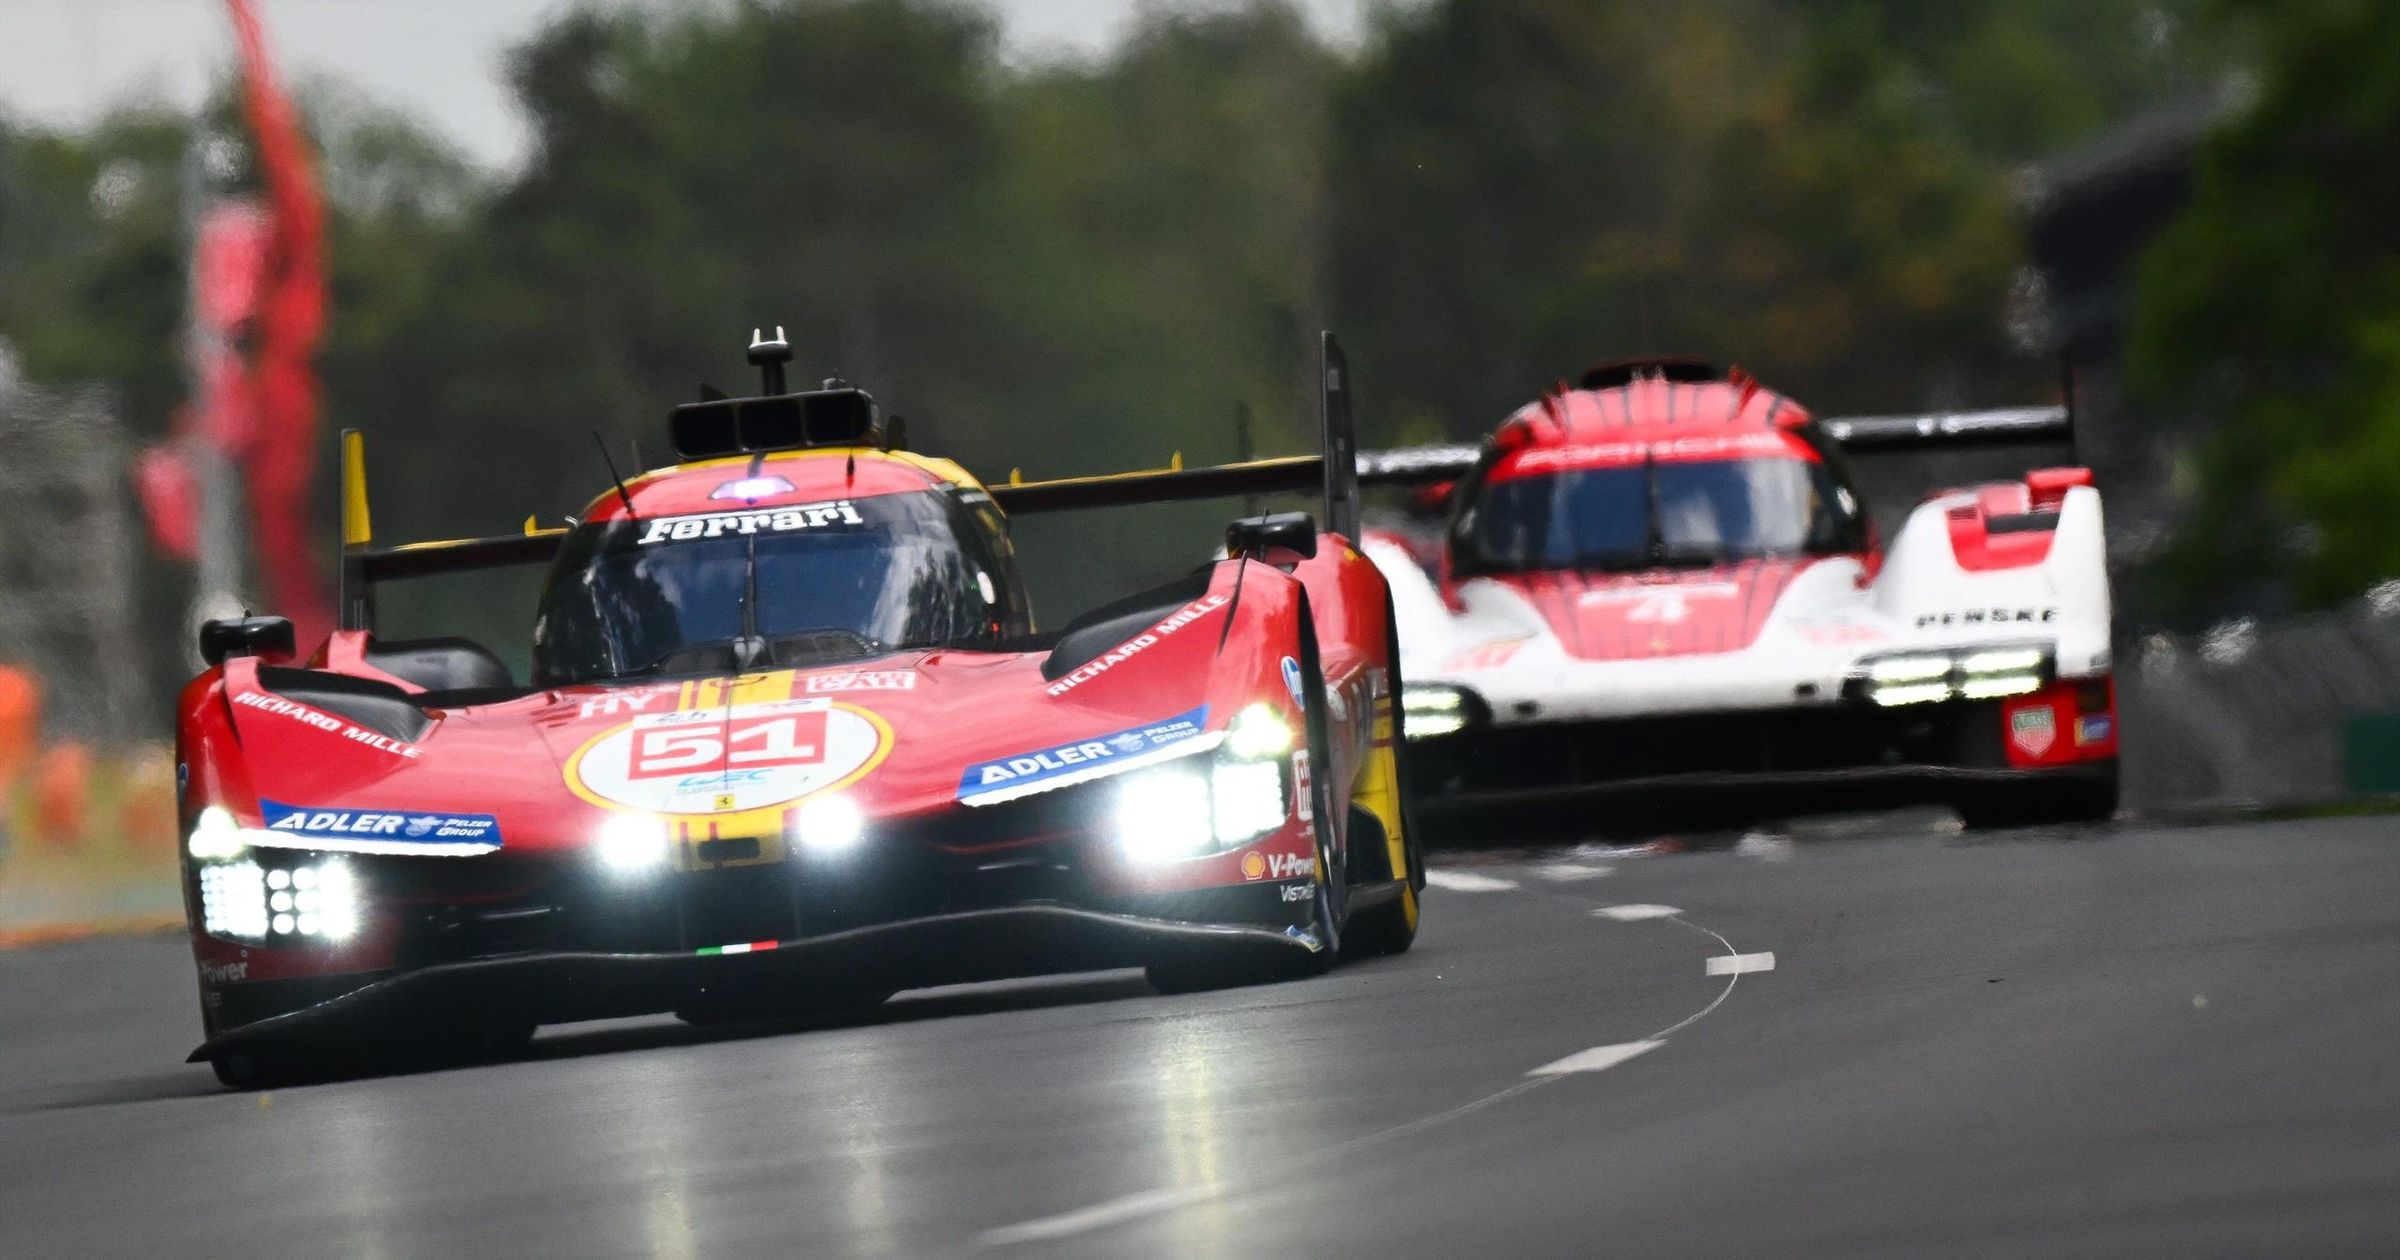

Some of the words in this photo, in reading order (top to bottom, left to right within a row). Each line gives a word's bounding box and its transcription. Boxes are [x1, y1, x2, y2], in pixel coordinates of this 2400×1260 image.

[637, 500, 863, 545] Ferrari
[1916, 607, 2057, 627] PENSKE
[1046, 634, 1158, 697] RICHARD
[1155, 594, 1230, 635] MILLE
[233, 691, 344, 732] RICHARD
[341, 726, 424, 758] MILLE
[1143, 721, 1193, 738] PELZER
[640, 718, 815, 771] 51
[1150, 727, 1199, 744] GROUP
[981, 741, 1113, 785] ADLER
[678, 768, 774, 788] WEC
[270, 812, 405, 835] ADLER
[436, 827, 485, 837] GROUP
[443, 818, 493, 828] PELZER
